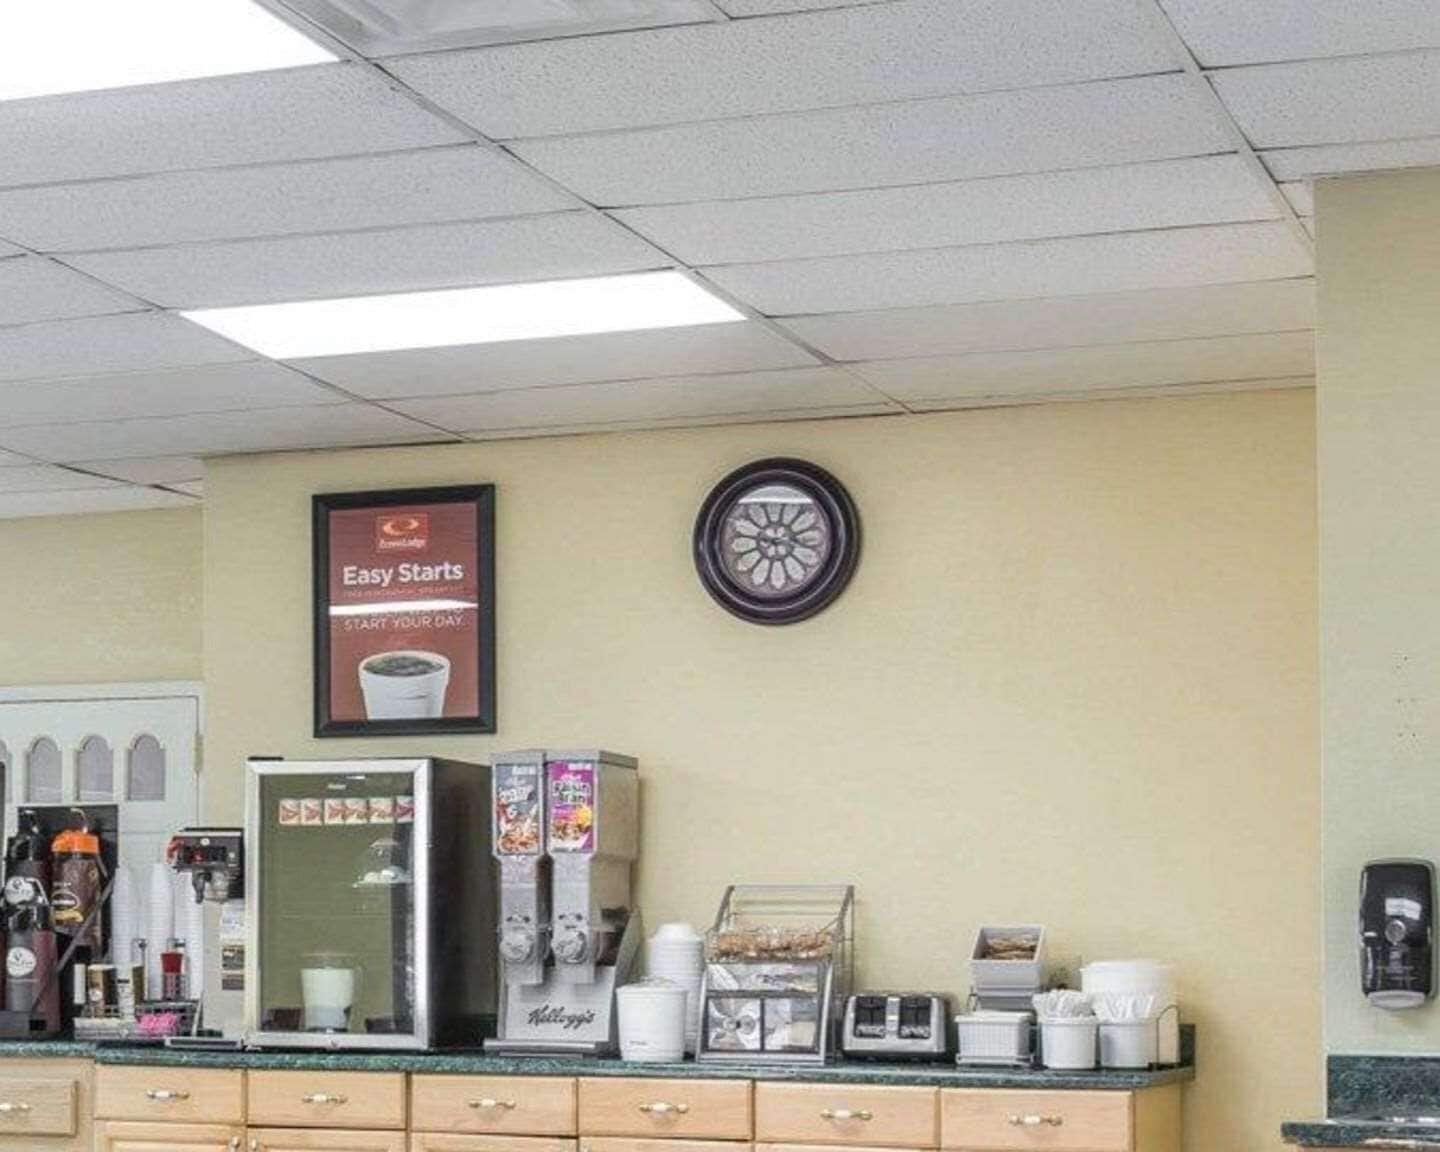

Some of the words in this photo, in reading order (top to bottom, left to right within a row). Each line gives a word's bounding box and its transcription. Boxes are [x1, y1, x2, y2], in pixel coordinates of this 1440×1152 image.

[342, 565, 394, 587] Easy
[398, 561, 464, 582] Starts
[344, 617, 386, 631] START
[392, 615, 432, 629] YOUR
[527, 1004, 595, 1029] Kellogg's
